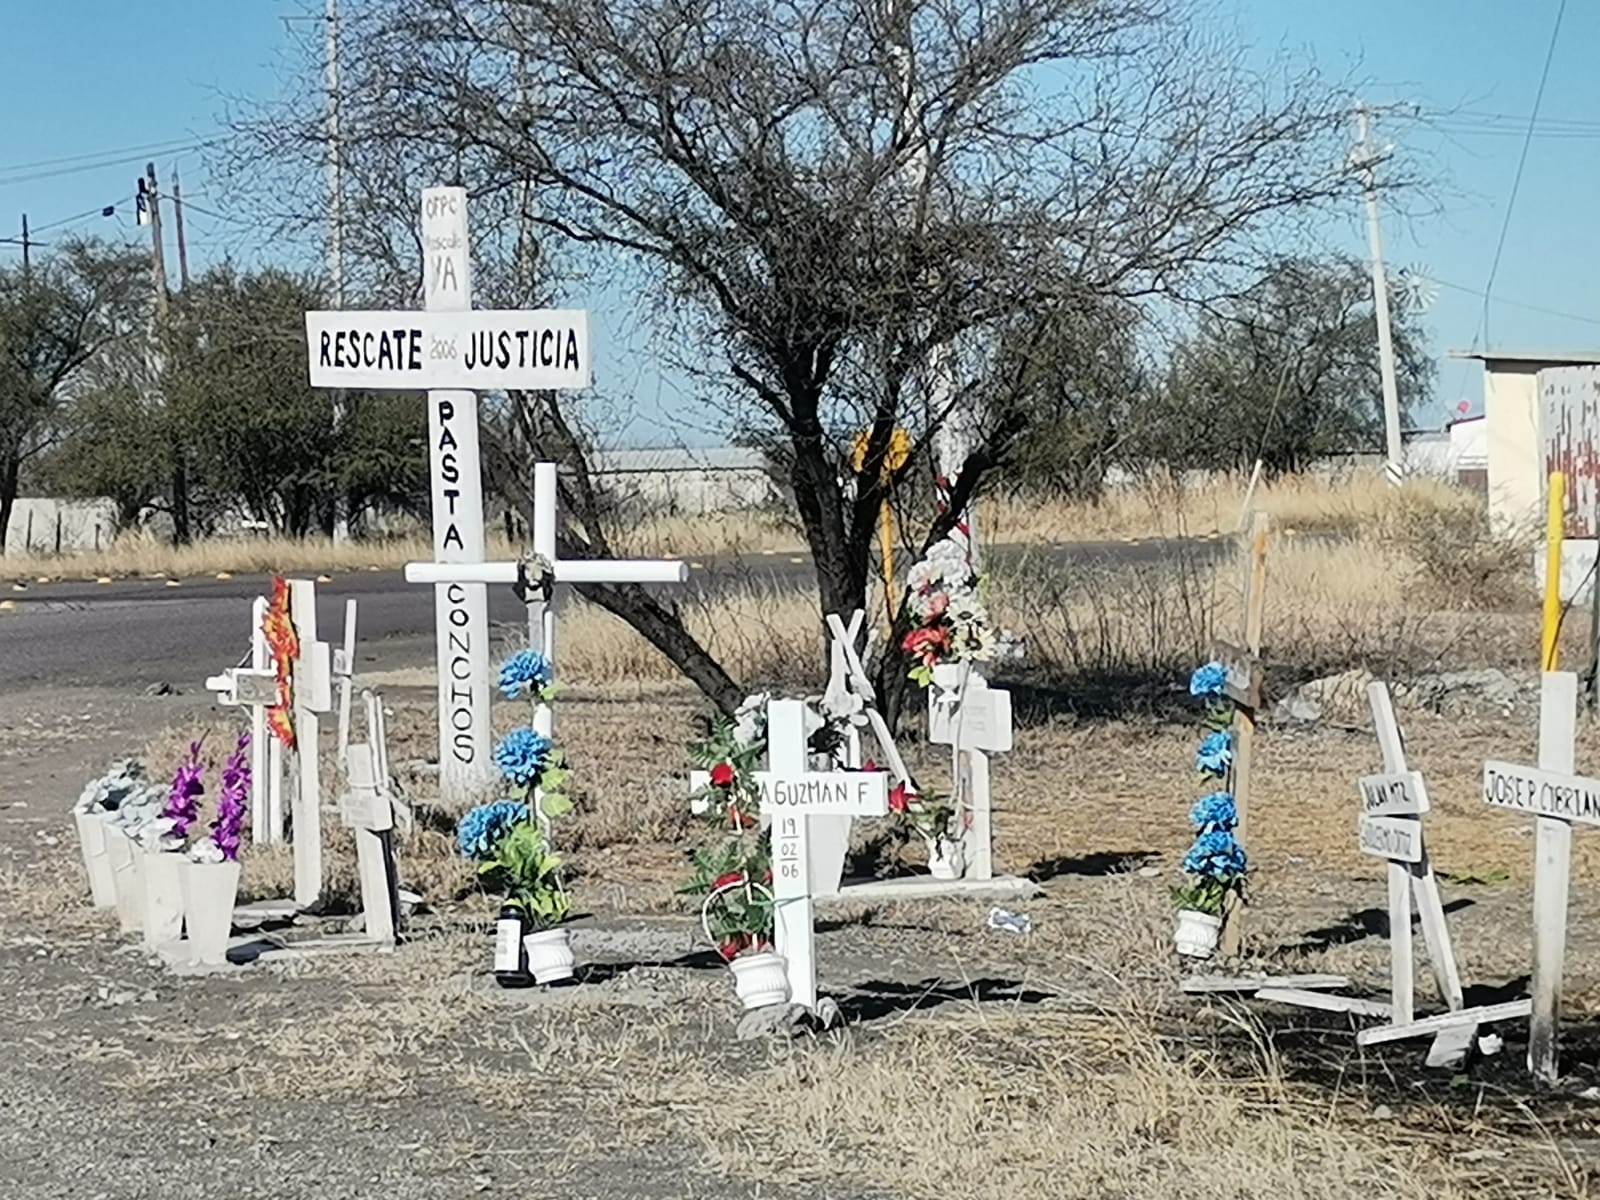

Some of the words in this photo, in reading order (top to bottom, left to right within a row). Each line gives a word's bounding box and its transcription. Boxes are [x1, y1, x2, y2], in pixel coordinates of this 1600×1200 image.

[319, 329, 422, 370] RESCATE
[430, 337, 457, 360] 2006
[464, 328, 579, 371] JUSTICIA
[438, 400, 464, 550] PASTA
[447, 583, 475, 764] CONCHOS
[858, 782, 869, 804] F
[1485, 770, 1524, 807] JOSE
[781, 818, 796, 834] 19
[781, 843, 797, 856] 02
[781, 864, 799, 878] 06
